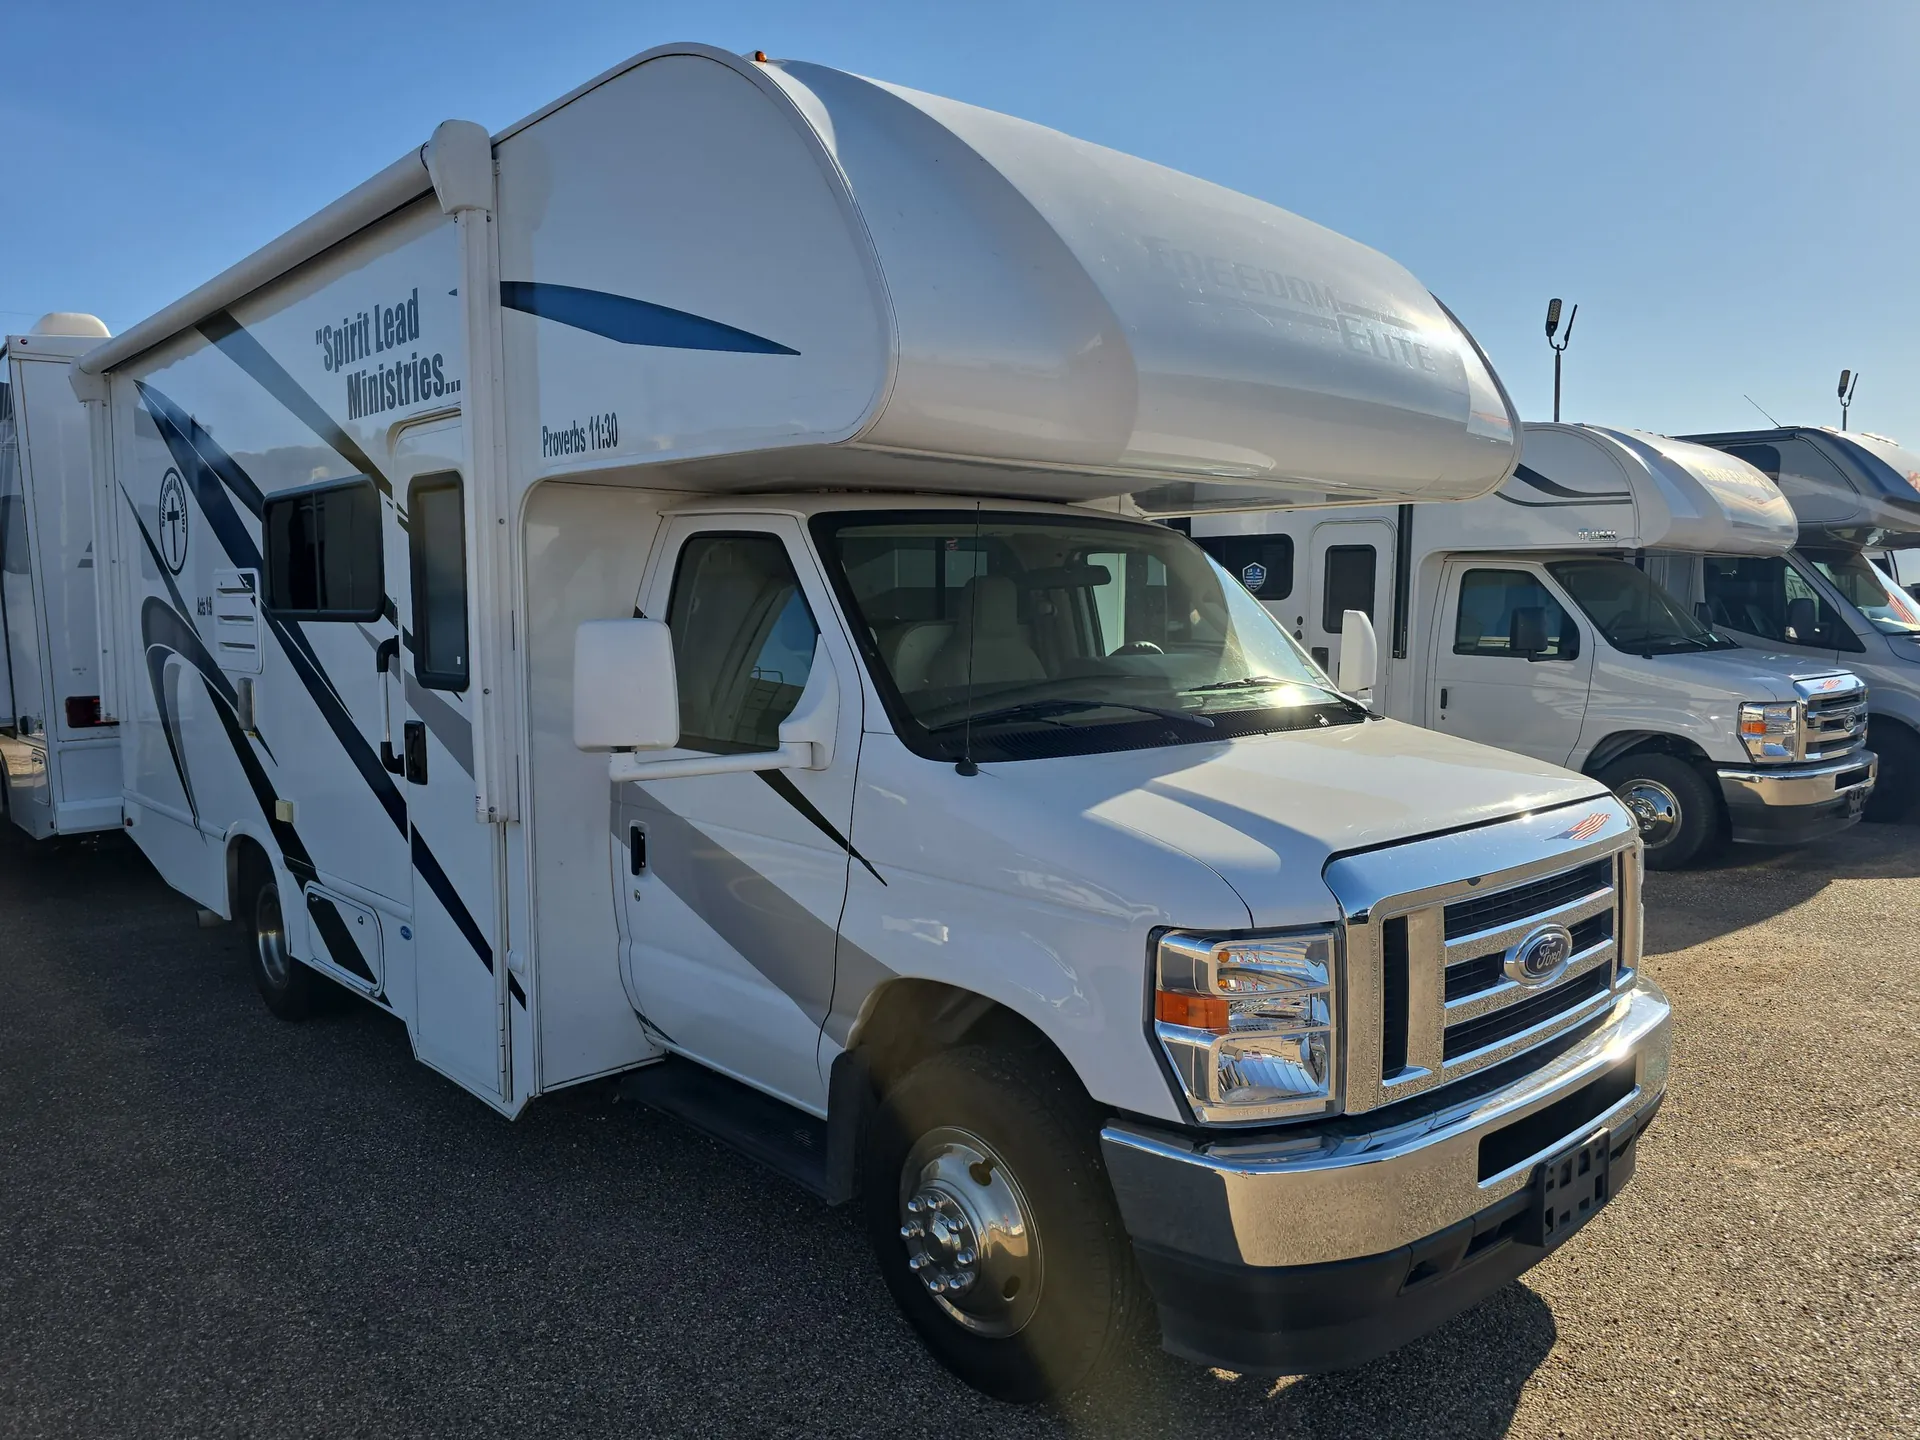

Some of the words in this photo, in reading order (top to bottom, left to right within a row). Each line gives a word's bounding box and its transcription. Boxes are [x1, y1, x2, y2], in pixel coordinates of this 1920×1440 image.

[316, 312, 371, 373] "Spirit
[374, 287, 420, 353] Lead
[1336, 313, 1437, 373] ELITE
[347, 352, 461, 420] Ministries...
[542, 420, 586, 458] Proverbs
[589, 412, 618, 450] 11:30
[1536, 941, 1563, 969] Ford
